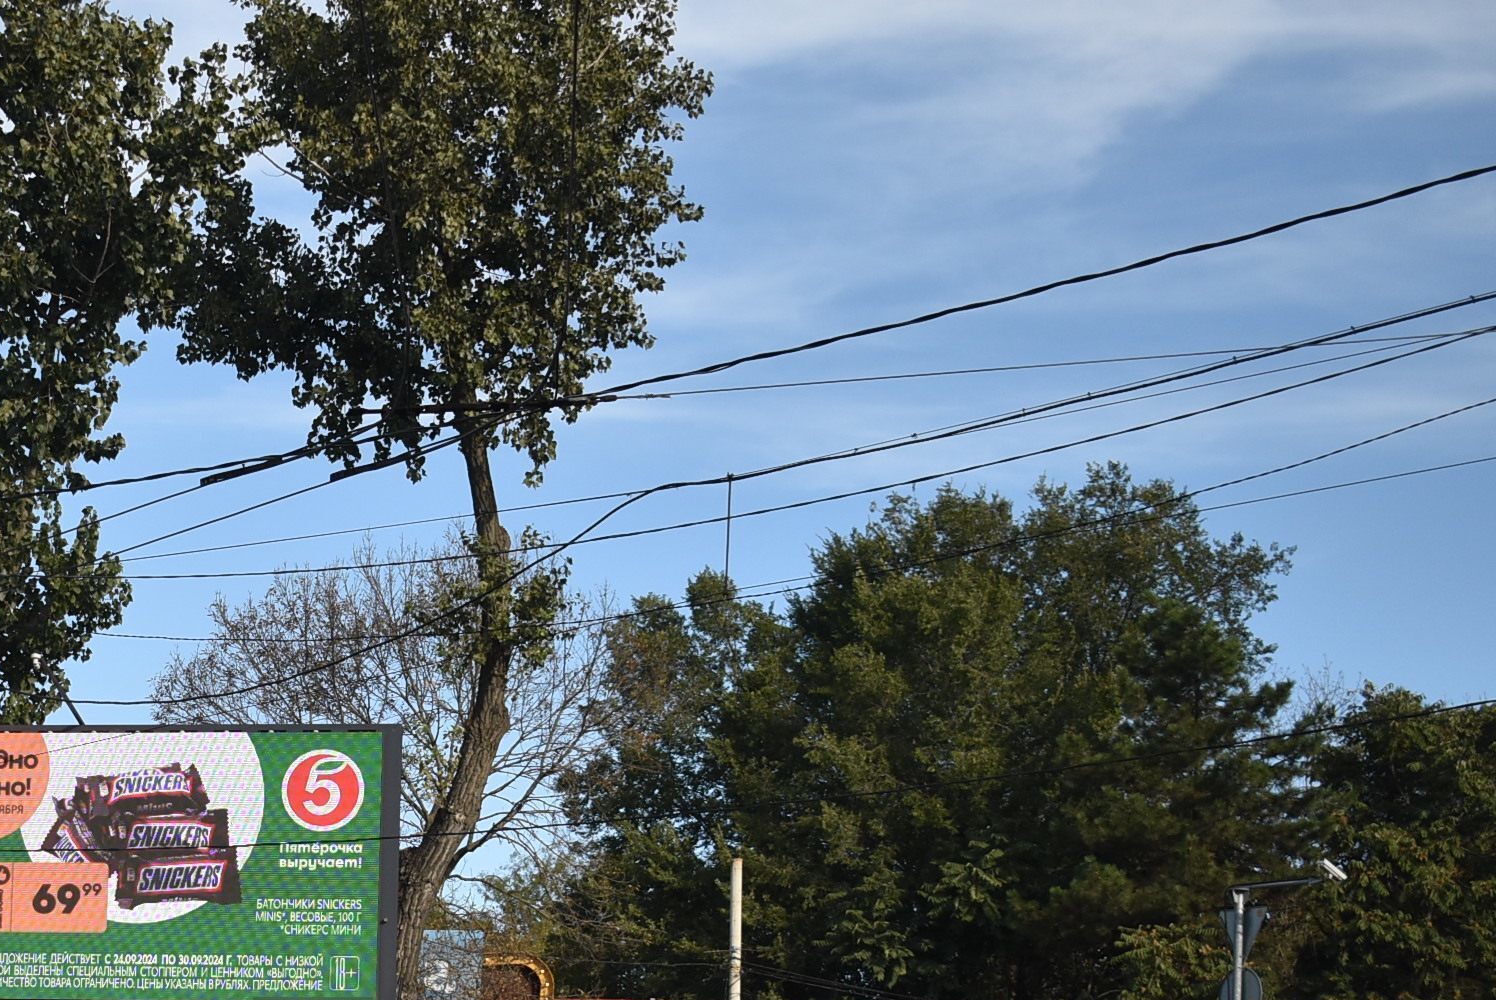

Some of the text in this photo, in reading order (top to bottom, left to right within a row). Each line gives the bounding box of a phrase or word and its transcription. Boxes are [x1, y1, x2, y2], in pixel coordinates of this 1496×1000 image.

[128, 824, 210, 848] SNICKERS
[279, 841, 363, 856] Пятёрочка
[279, 857, 363, 871] выручает!
[138, 865, 222, 891] SNICKERS
[32, 883, 81, 915] 69
[256, 899, 362, 910] БАТОНЧИКИ SNICKERS
[290, 911, 337, 924] ВЕСОВЫЕ,
[338, 912, 355, 923] 100
[331, 924, 361, 936] МИНИ
[50, 953, 101, 966] ДЕЙСТВУЕТ
[104, 954, 110, 964] С
[113, 954, 158, 965] 24.09.2024
[161, 954, 176, 965] ПО
[178, 954, 224, 966] 30.09.2024
[237, 955, 273, 966] ТОВАРЫ
[275, 955, 283, 966] С
[285, 953, 324, 967] НИЗКОЙ
[13, 965, 64, 977] ВЫДЕЛЕНЫ
[66, 965, 137, 978] СПЕЦИАЛЬНЫМ
[139, 966, 197, 978] СТОППЕРОМ
[201, 966, 208, 977] И
[210, 967, 264, 979] ЦЕННИКОМ
[335, 957, 357, 990] 18+
[38, 977, 72, 988] ТОВАРА
[136, 978, 163, 990] ЦЕНЫ
[164, 978, 207, 990] УКАЗАНЫ
[208, 979, 214, 990] В
[215, 979, 251, 990] РУБЛЯХ.
[252, 979, 323, 991] ПРЕДЛОЖЕНИЕ
